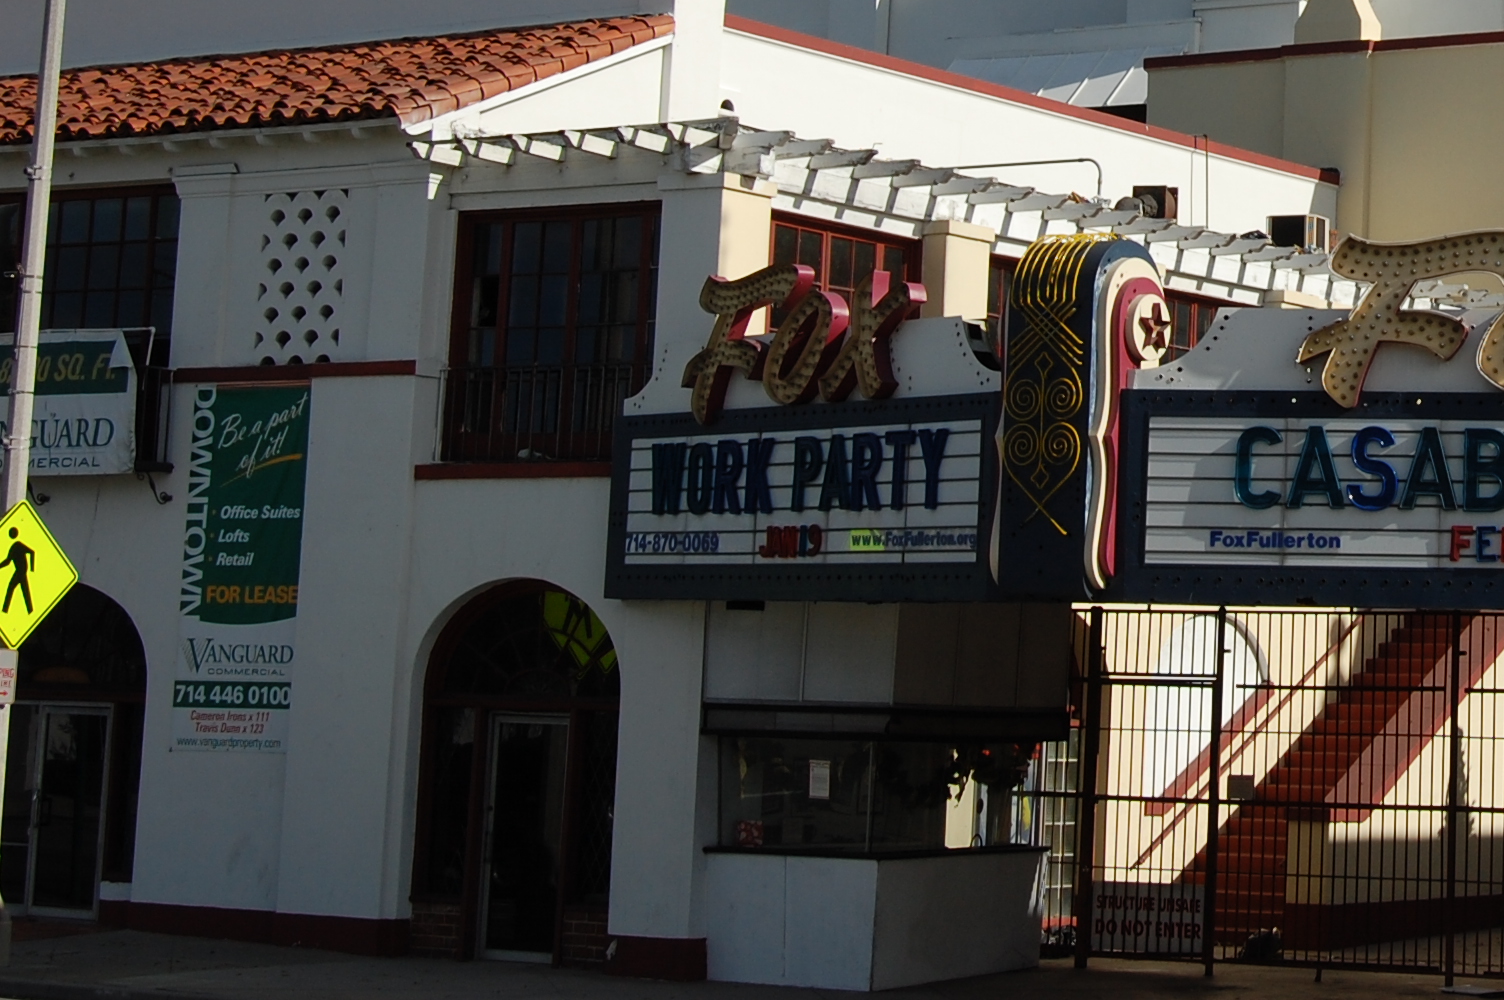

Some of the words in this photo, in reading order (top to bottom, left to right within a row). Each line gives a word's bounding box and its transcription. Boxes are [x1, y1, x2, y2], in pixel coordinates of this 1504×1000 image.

[681, 263, 927, 425] Fox
[54, 353, 84, 382] SQ.
[218, 413, 247, 449] Be
[249, 420, 262, 436] a
[263, 392, 308, 439] part
[235, 435, 263, 478] of
[260, 425, 289, 461] it!
[650, 437, 776, 516] WORK
[791, 428, 951, 513] PARTY
[180, 387, 218, 617] DOWNTOWN
[220, 505, 258, 519] Office
[261, 504, 301, 519] Suites
[218, 529, 250, 542] Lofts
[625, 531, 719, 553] 714-870-0069
[759, 525, 799, 558] JAN
[851, 529, 978, 548] www.FoxFullerton.org
[1209, 530, 1342, 551] FoxFullerton
[216, 552, 254, 566] Retail
[206, 585, 240, 604] FOR
[244, 585, 298, 604] LEASE
[187, 638, 294, 674] VANGUARD
[207, 668, 285, 676] COMMERCIAL
[176, 684, 206, 703] 714
[210, 685, 244, 704] 446
[248, 686, 291, 705] 0100
[190, 710, 225, 721] Cameron
[226, 711, 246, 721] Irons
[255, 711, 270, 722] 111
[196, 722, 219, 733] Travis
[220, 723, 240, 733] Dunn
[250, 723, 264, 734] 123
[176, 737, 281, 749] www.vanguardproperty.com
[1096, 895, 1155, 911] STRUCTURE
[1160, 897, 1201, 913] UNSAFE
[1095, 918, 1117, 935] DO
[1120, 919, 1152, 937] NOT
[1155, 922, 1201, 939] ENTER
